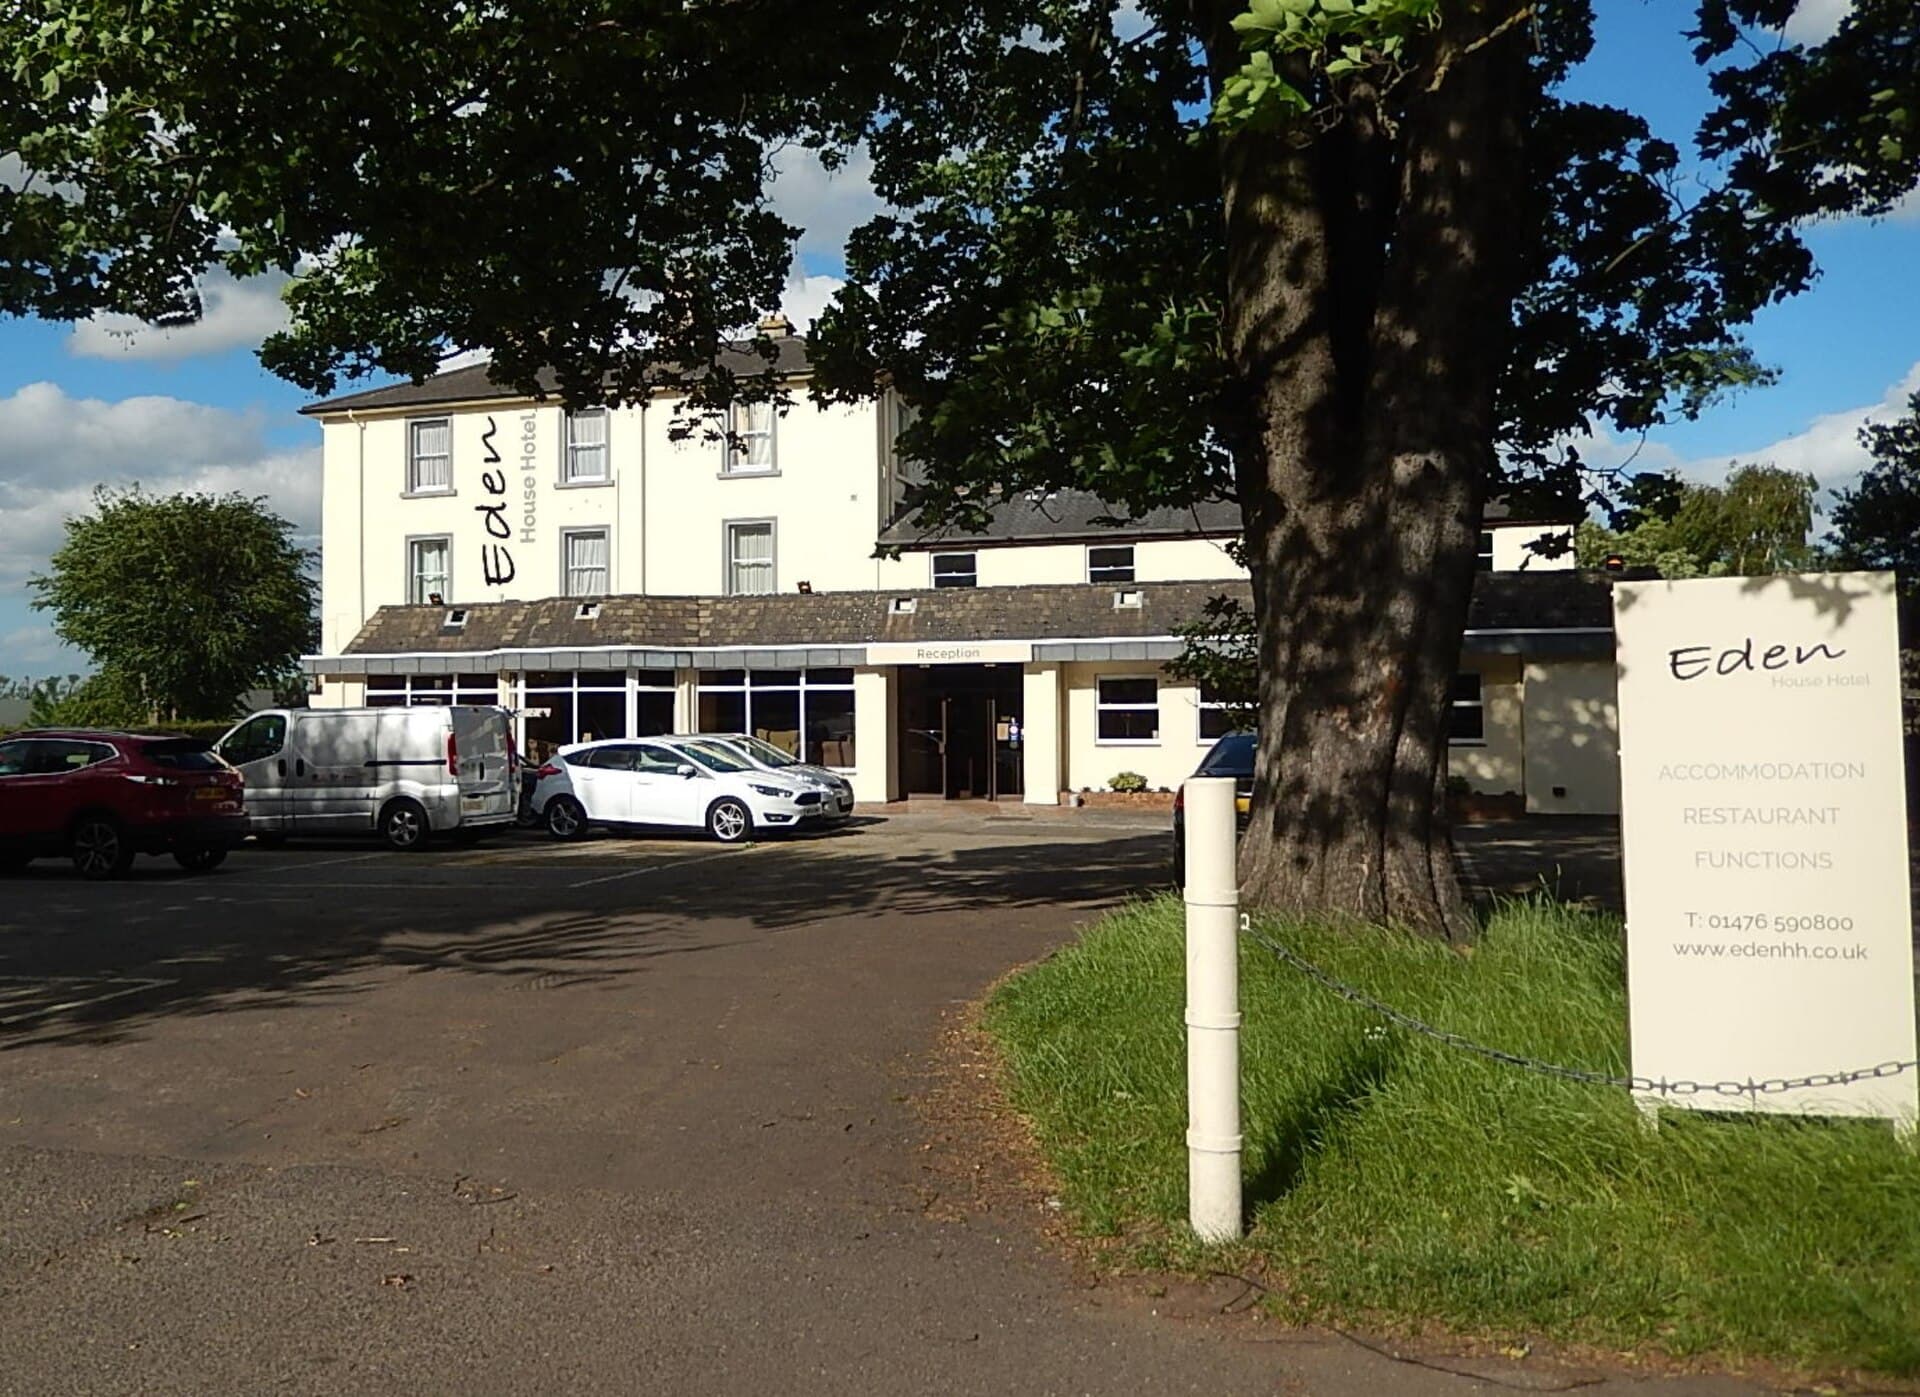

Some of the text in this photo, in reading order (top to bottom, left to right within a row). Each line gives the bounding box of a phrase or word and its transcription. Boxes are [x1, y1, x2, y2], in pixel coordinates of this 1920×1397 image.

[520, 413, 537, 544] House Hotel
[475, 415, 515, 586] Eden
[917, 647, 980, 660] Reception
[1669, 637, 1846, 680] Eden
[1771, 673, 1870, 688] House Hotel
[1658, 762, 1865, 781] ACCOMMODATION
[1683, 807, 1841, 825] RESTAURANT
[1695, 851, 1833, 870] FUNCTIONS
[1708, 913, 1768, 932] 01476
[1774, 914, 1854, 933] 590800
[1673, 942, 1869, 960] www.edenhh.co.uk
